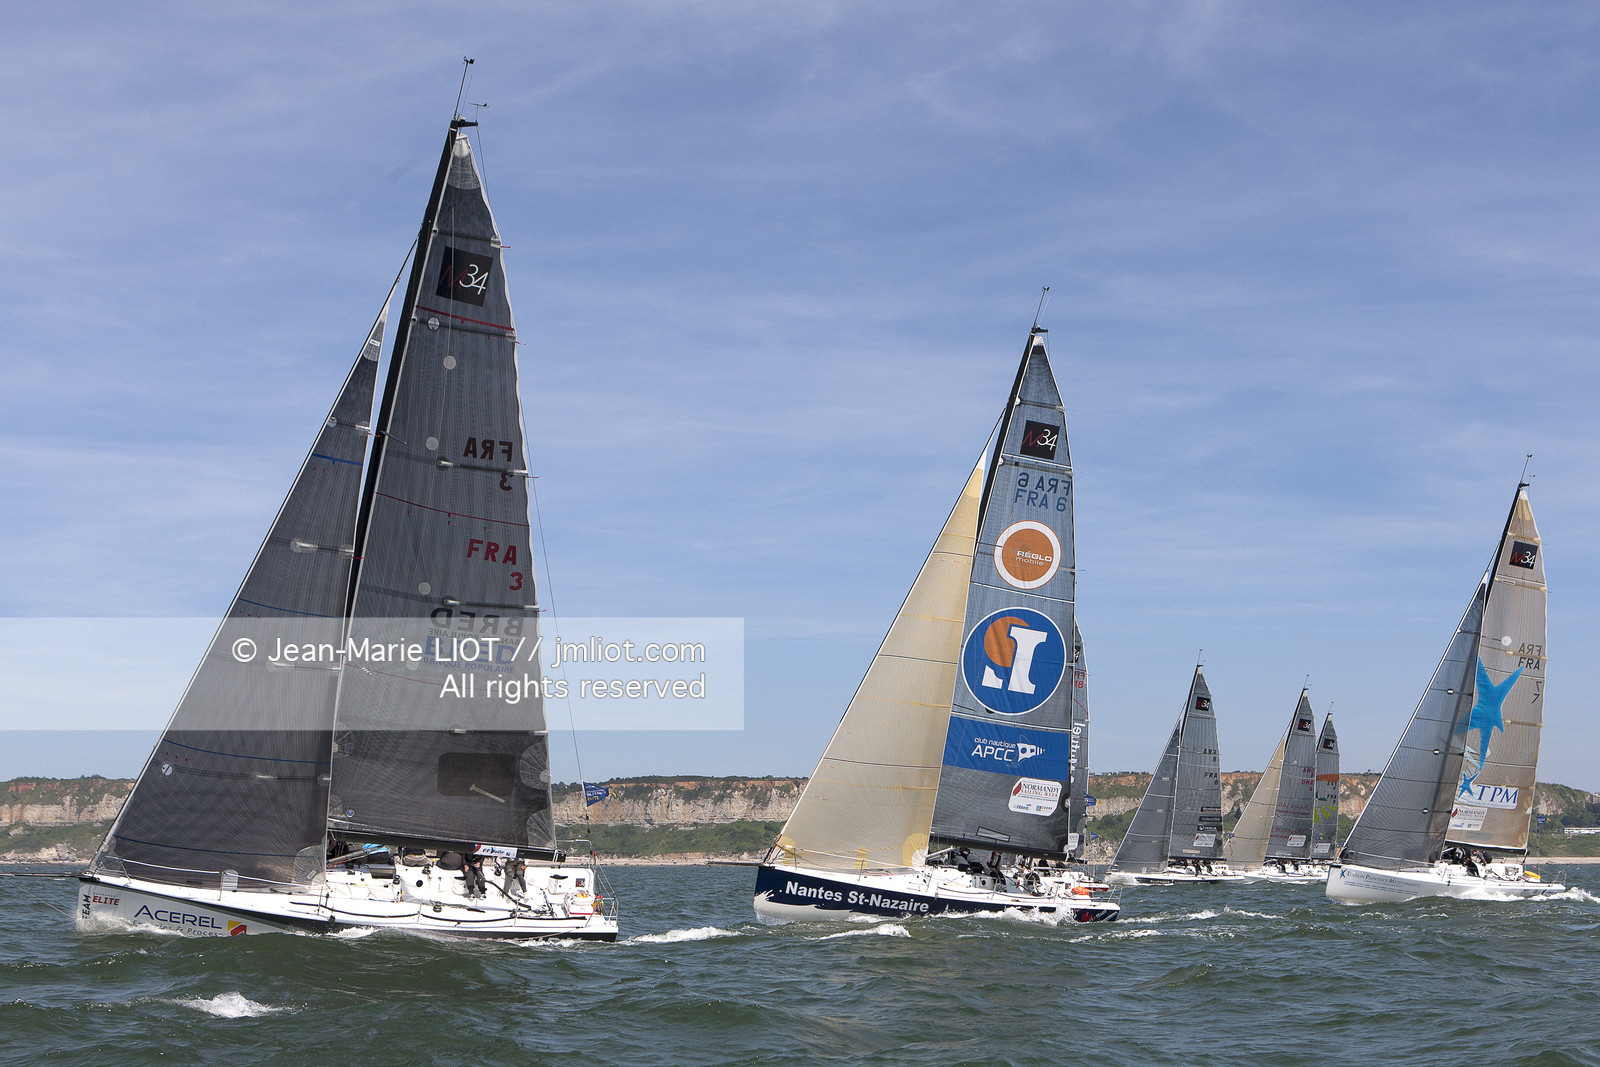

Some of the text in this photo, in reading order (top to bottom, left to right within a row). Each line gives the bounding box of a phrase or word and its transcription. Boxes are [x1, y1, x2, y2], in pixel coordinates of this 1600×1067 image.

[439, 264, 489, 295] M34
[1022, 429, 1058, 450] M34
[1014, 489, 1068, 512] FRA 6
[467, 539, 517, 565] FRA
[1017, 551, 1053, 562] RÉGLO
[1510, 551, 1536, 567] M34
[1016, 557, 1044, 566] mobile
[509, 572, 523, 591] 3
[465, 661, 515, 674] POPULAIRE
[1518, 657, 1540, 671] FRA
[1532, 693, 1540, 704] 7
[974, 737, 1016, 749] club nautique
[971, 744, 1015, 762] APCC
[1022, 783, 1060, 794] NORMANDY
[1476, 784, 1519, 804] TPM
[92, 895, 120, 906] ELITE
[786, 880, 929, 913] Nantes St-Nazaire
[134, 904, 222, 929] ACEREL
